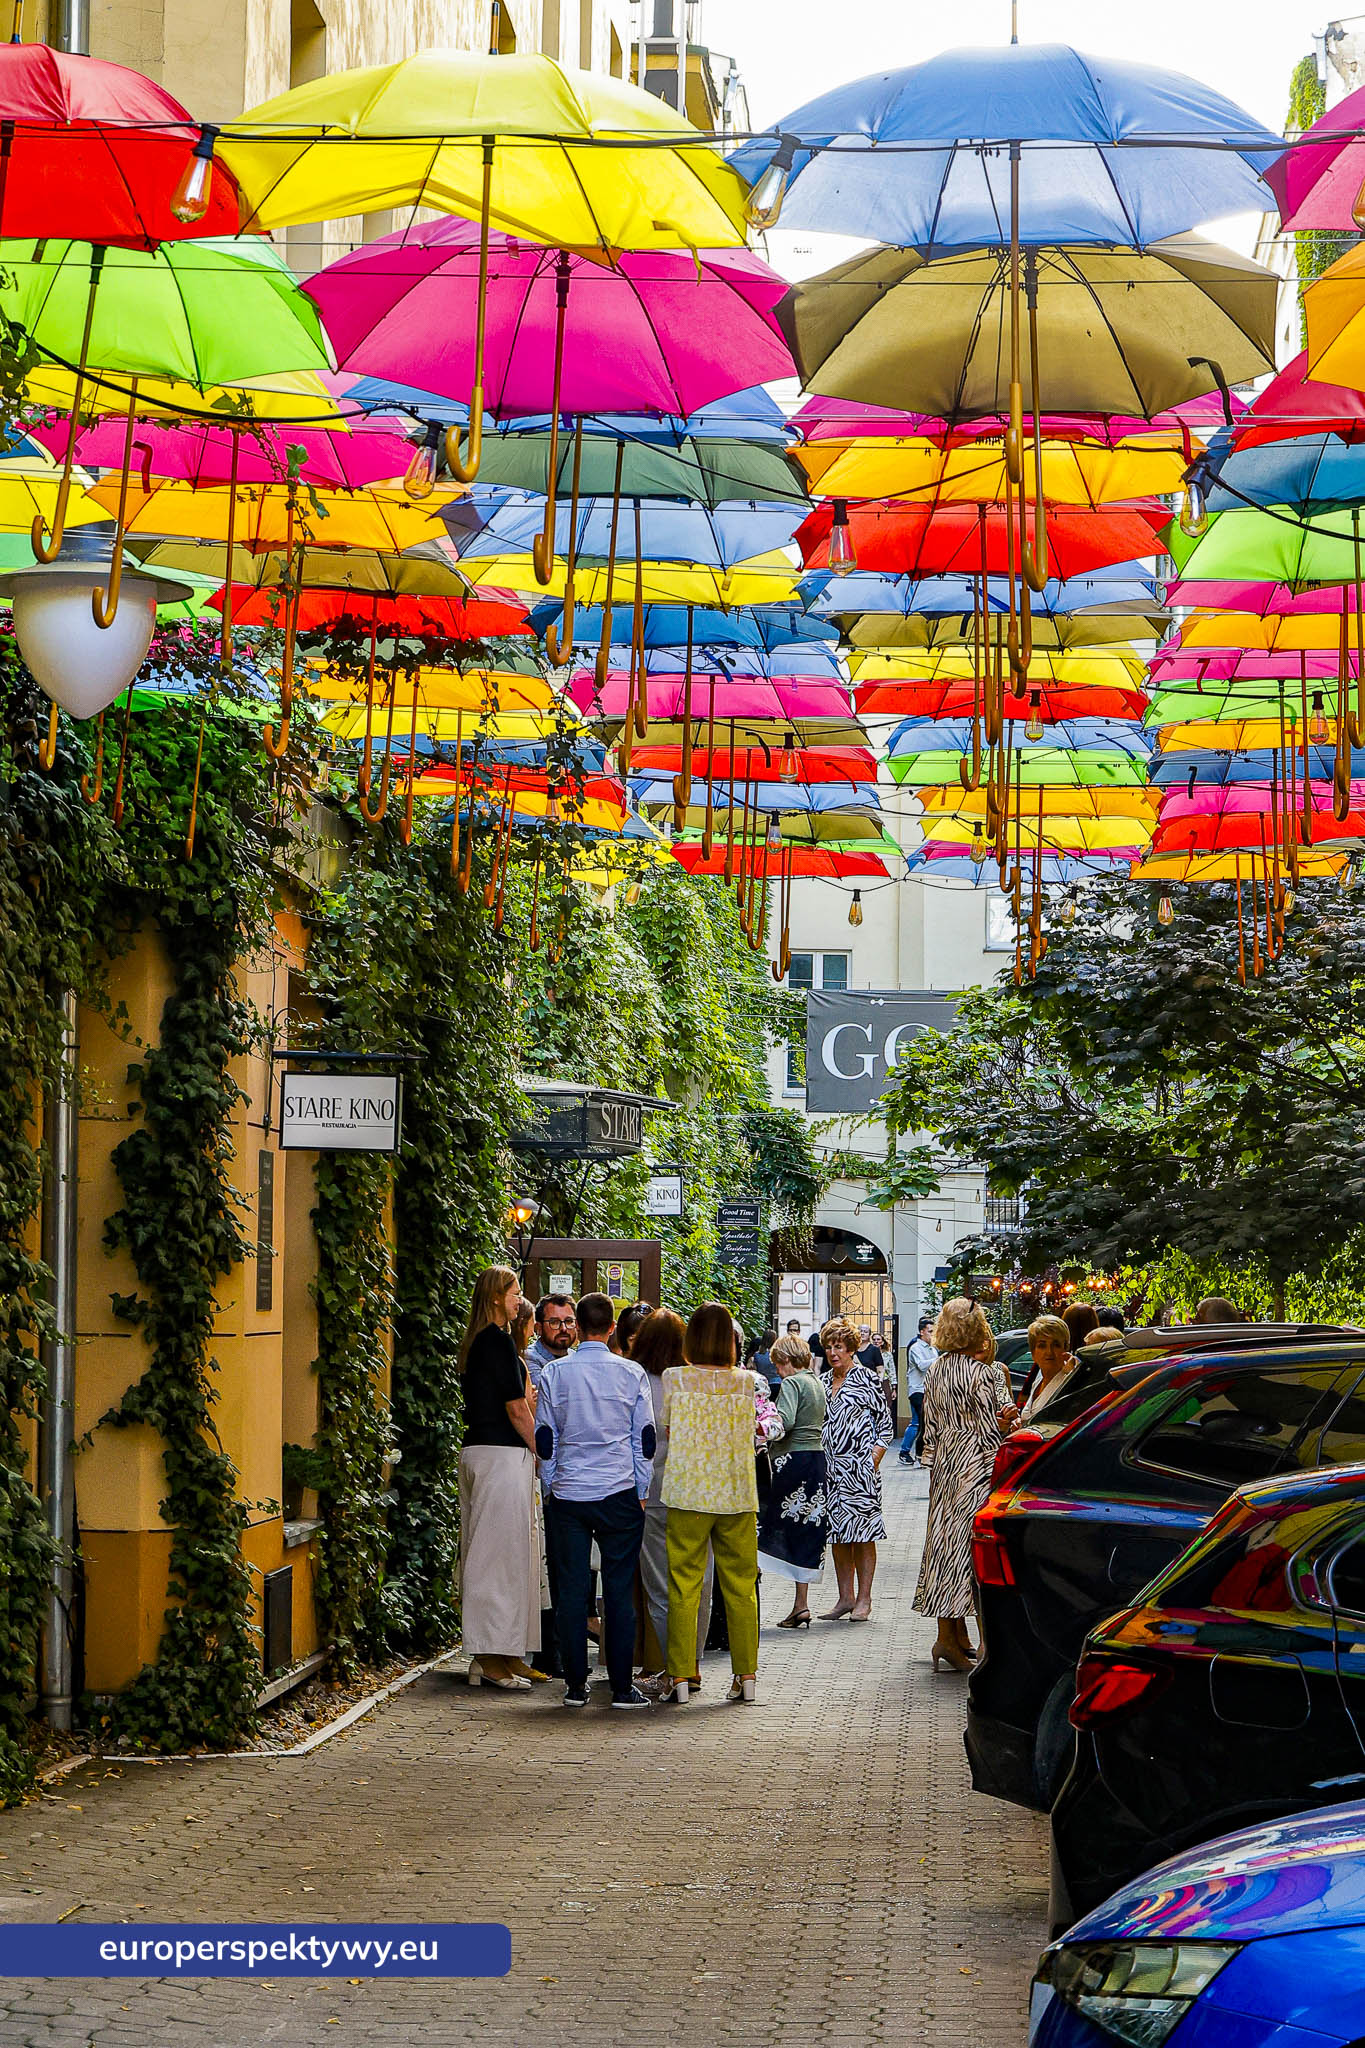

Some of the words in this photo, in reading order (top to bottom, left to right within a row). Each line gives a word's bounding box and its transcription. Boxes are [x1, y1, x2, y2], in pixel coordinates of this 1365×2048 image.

[284, 1096, 343, 1119] STARE
[349, 1098, 395, 1121] KINO
[656, 1188, 679, 1200] KINO
[721, 1208, 739, 1216] Good
[739, 1209, 756, 1217] Time
